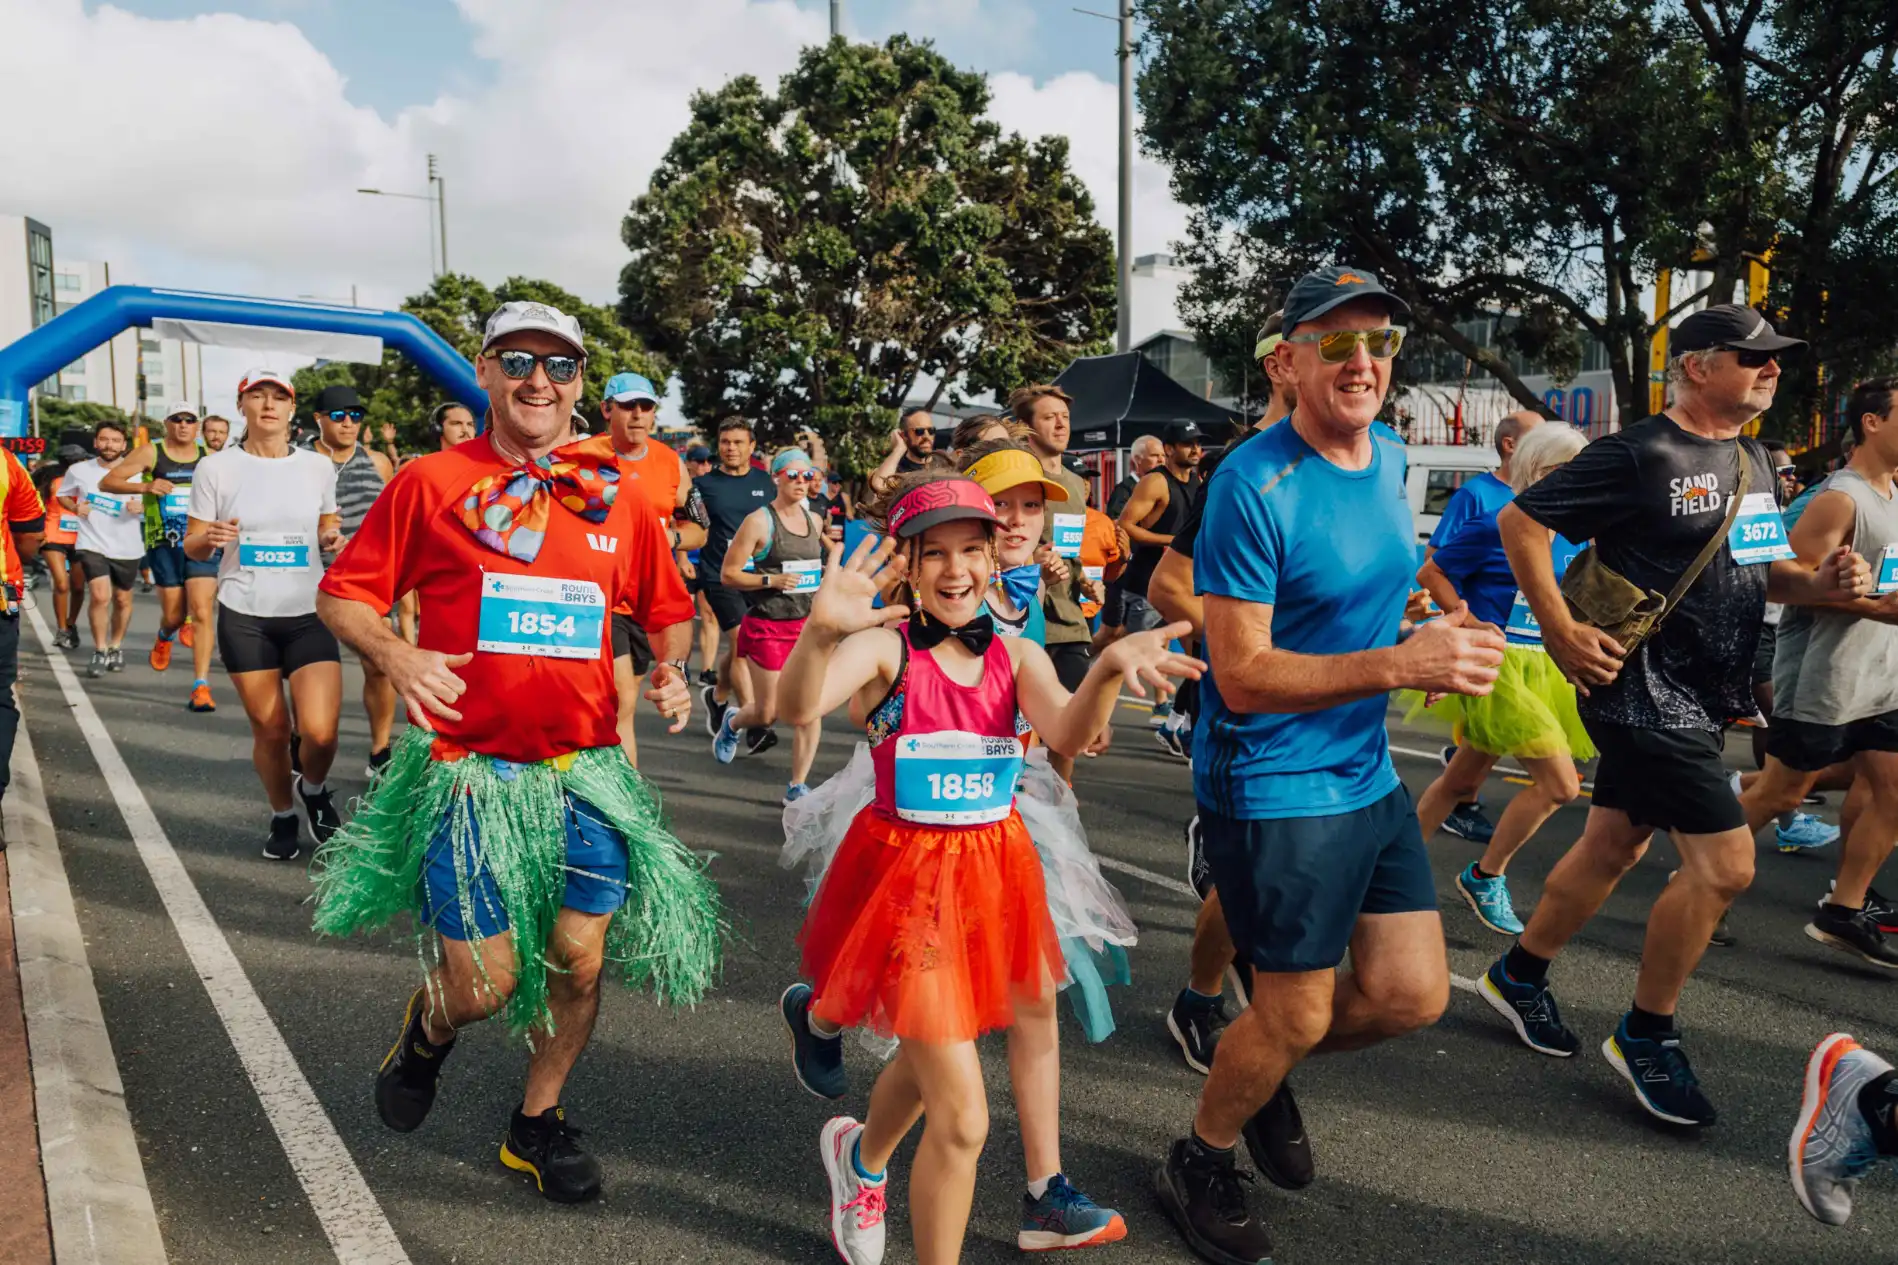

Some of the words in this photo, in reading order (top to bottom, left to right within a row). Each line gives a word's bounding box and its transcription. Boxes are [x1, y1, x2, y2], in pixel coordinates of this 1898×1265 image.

[1530, 386, 1594, 427] GO
[1669, 472, 1719, 498] SAND
[1671, 491, 1721, 517] FIELD
[1742, 521, 1779, 542] 3672
[254, 550, 297, 564] 3032
[561, 583, 598, 595] ROUND
[564, 592, 597, 604] BAYS
[507, 611, 577, 638] 1854
[985, 744, 1016, 756] BAYS
[926, 772, 996, 801] 1858
